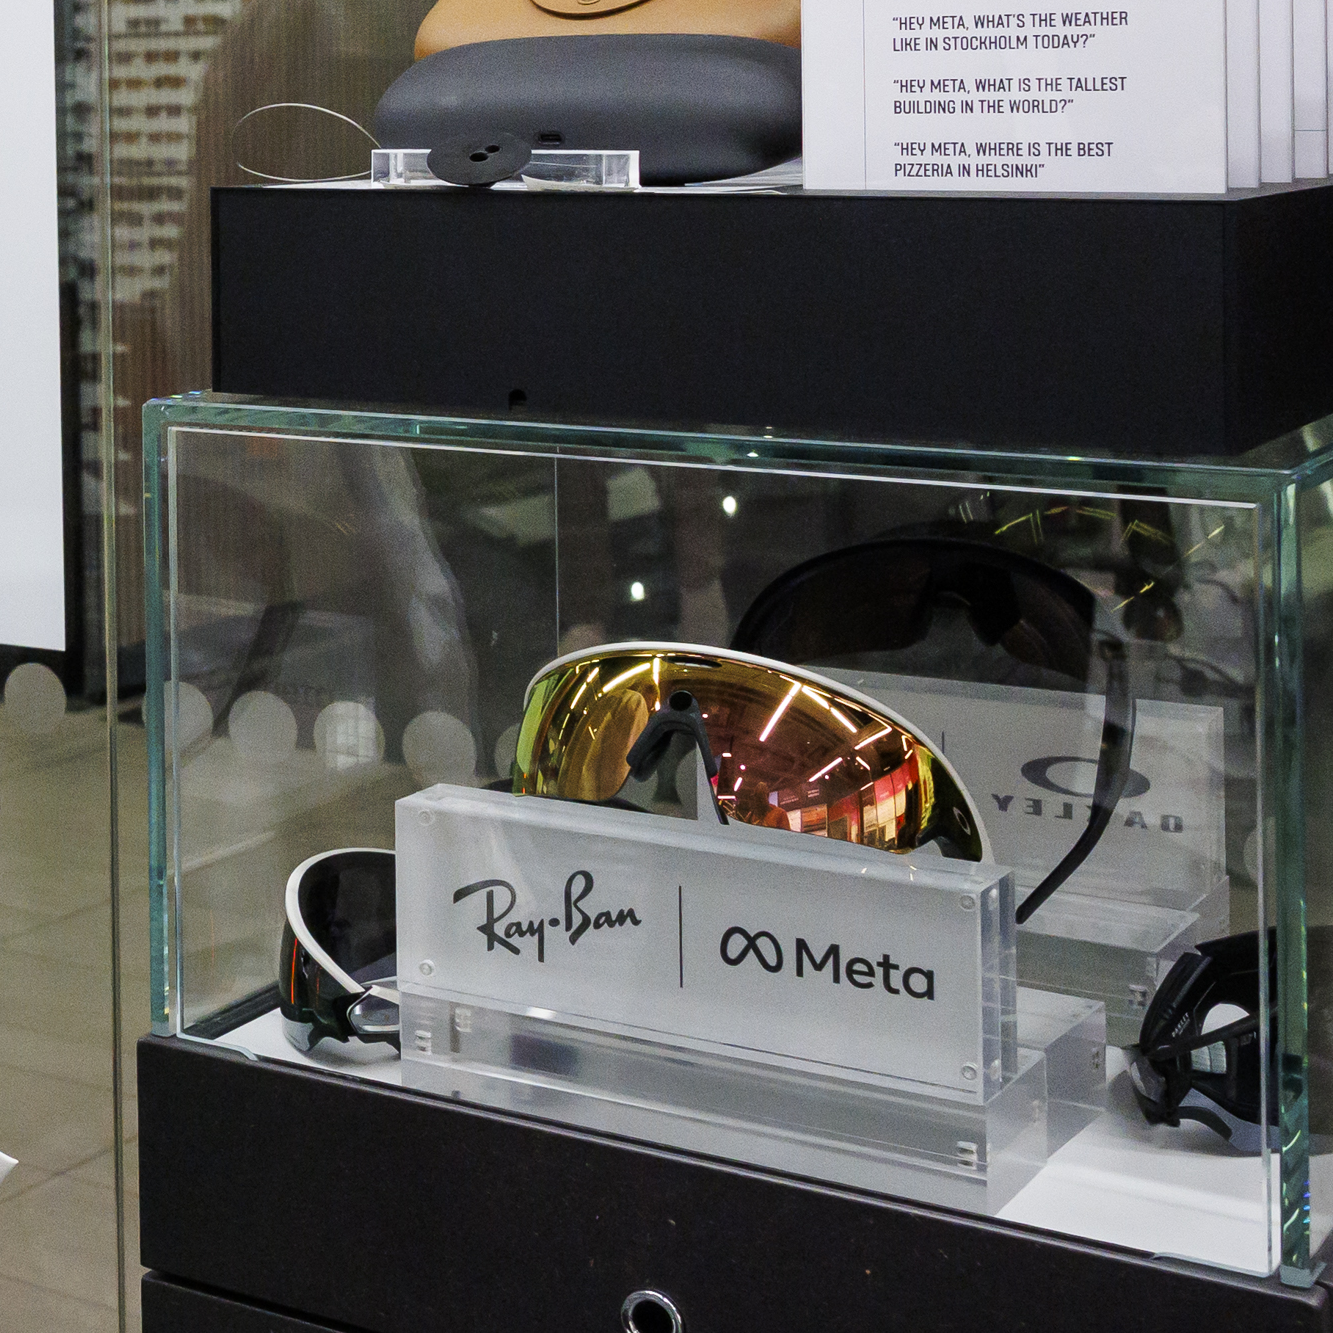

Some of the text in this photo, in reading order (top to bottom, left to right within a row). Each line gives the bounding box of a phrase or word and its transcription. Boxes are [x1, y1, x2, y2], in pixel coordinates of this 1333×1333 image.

[929, 14, 970, 32] META,
[1028, 12, 1057, 28] THE
[1060, 10, 1129, 28] WEATHER
[892, 36, 922, 52] LIKE
[925, 36, 939, 52] IN
[942, 34, 1028, 52] STOCKHOLM
[929, 78, 971, 95] META,
[974, 77, 1014, 93] WHAT
[1018, 77, 1032, 93] IS
[1034, 76, 1063, 93] THE
[1065, 76, 1128, 92] TALLEST
[893, 99, 956, 115] BUILDING
[960, 99, 974, 115] IN
[977, 98, 1005, 114] THE
[930, 141, 972, 159] META,
[974, 141, 1024, 157] WHERE
[1027, 141, 1042, 158] IS
[1044, 141, 1073, 158] THE
[1076, 141, 1115, 158] BEST
[894, 162, 954, 178] PIZZERIA
[957, 162, 971, 178] IN
[795, 936, 936, 1002] Meta
